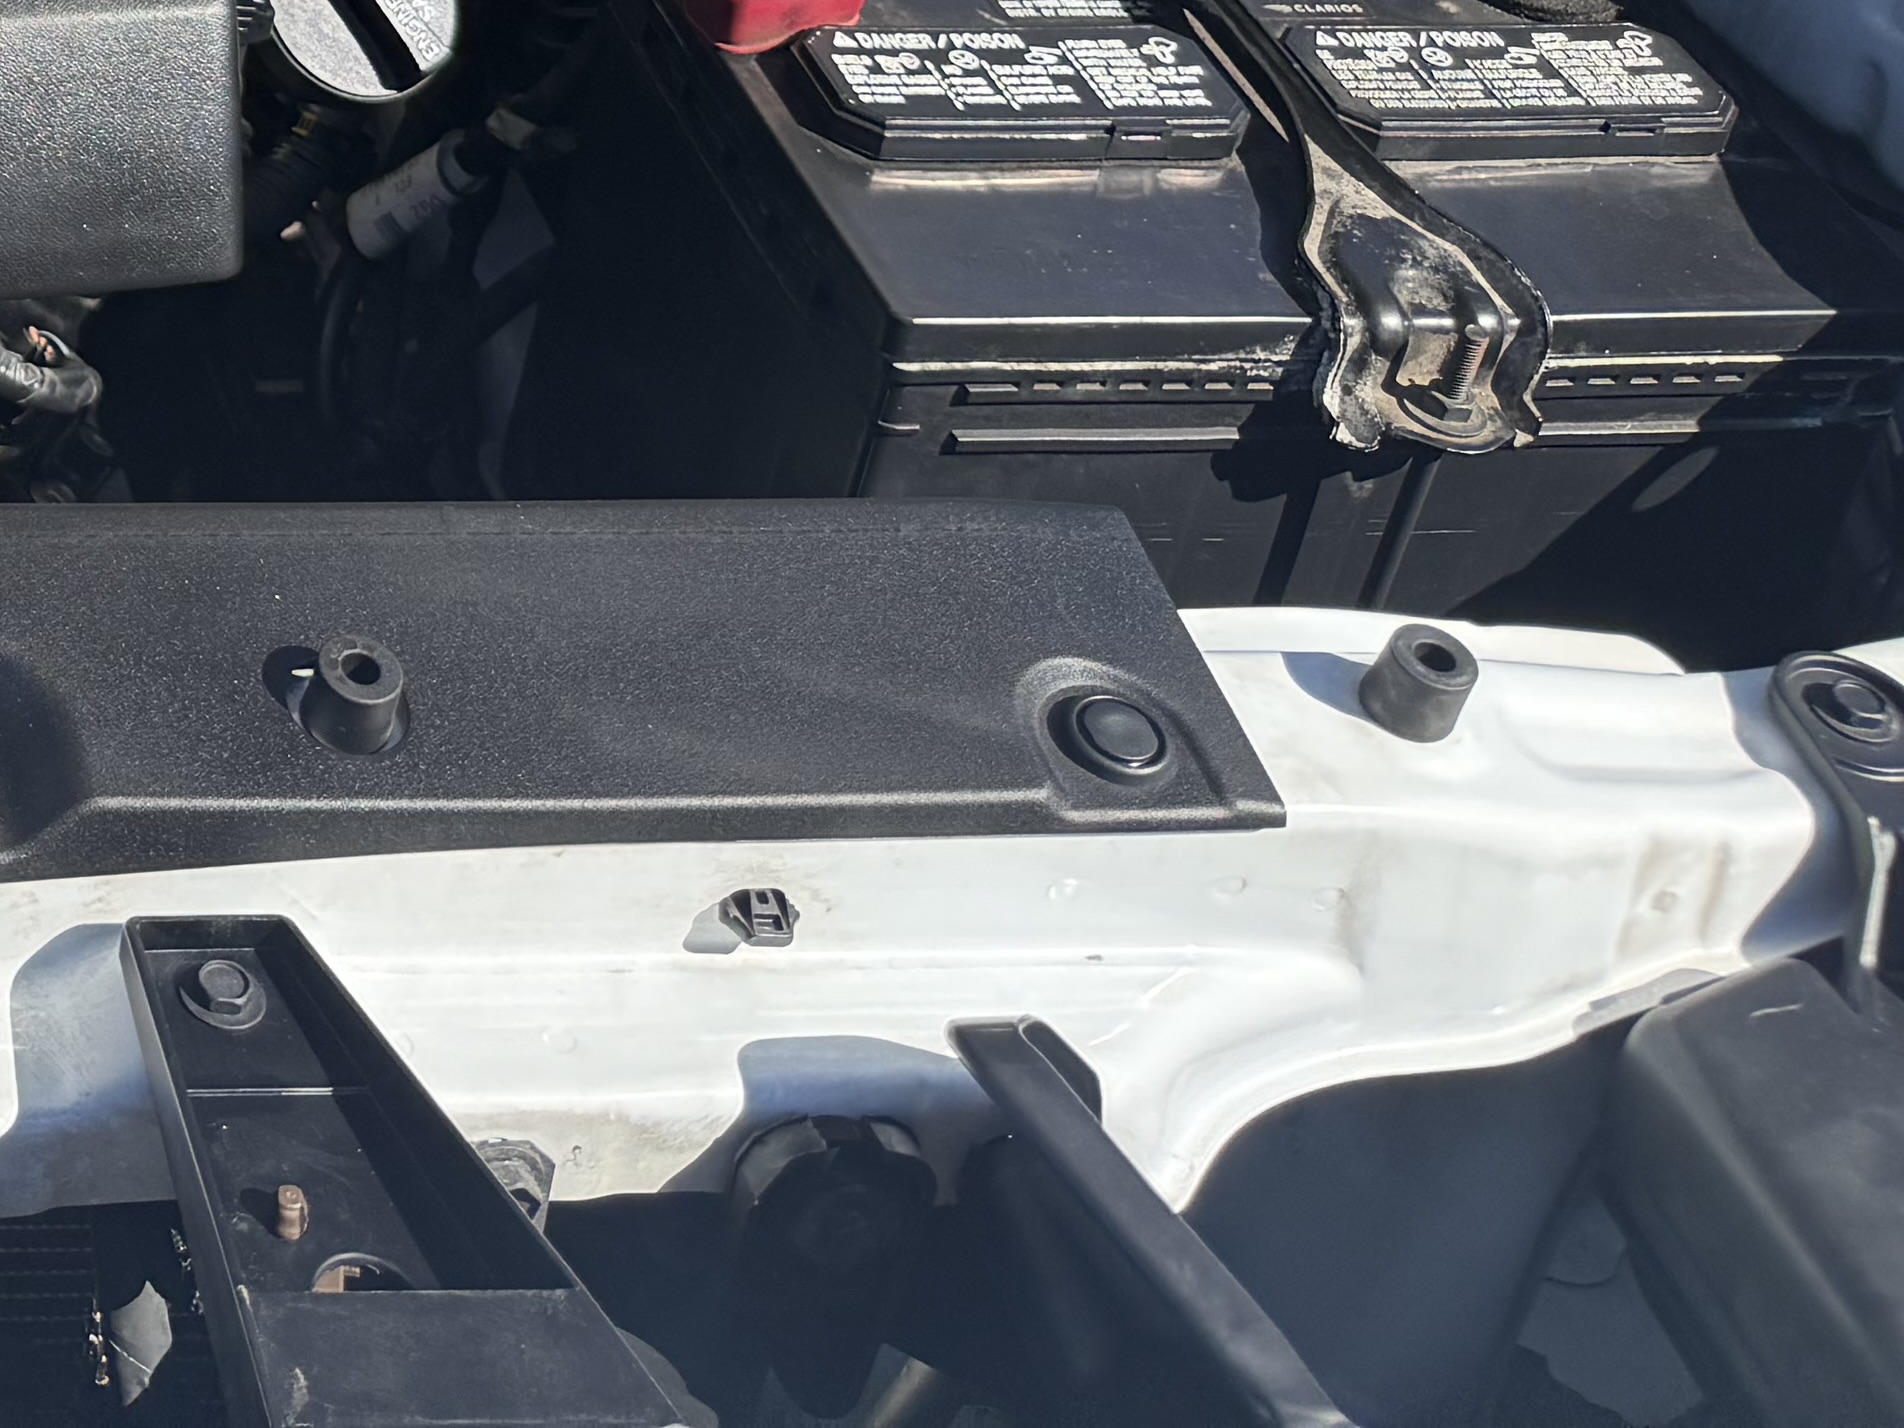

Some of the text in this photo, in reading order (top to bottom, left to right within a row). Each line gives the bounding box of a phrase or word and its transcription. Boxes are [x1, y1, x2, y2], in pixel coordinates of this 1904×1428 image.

[1293, 4, 1363, 13] CLARIOS
[855, 32, 939, 50] DANGER
[950, 32, 1025, 50] POISON
[1338, 31, 1417, 47] DANGER
[1430, 31, 1506, 47] POISON
